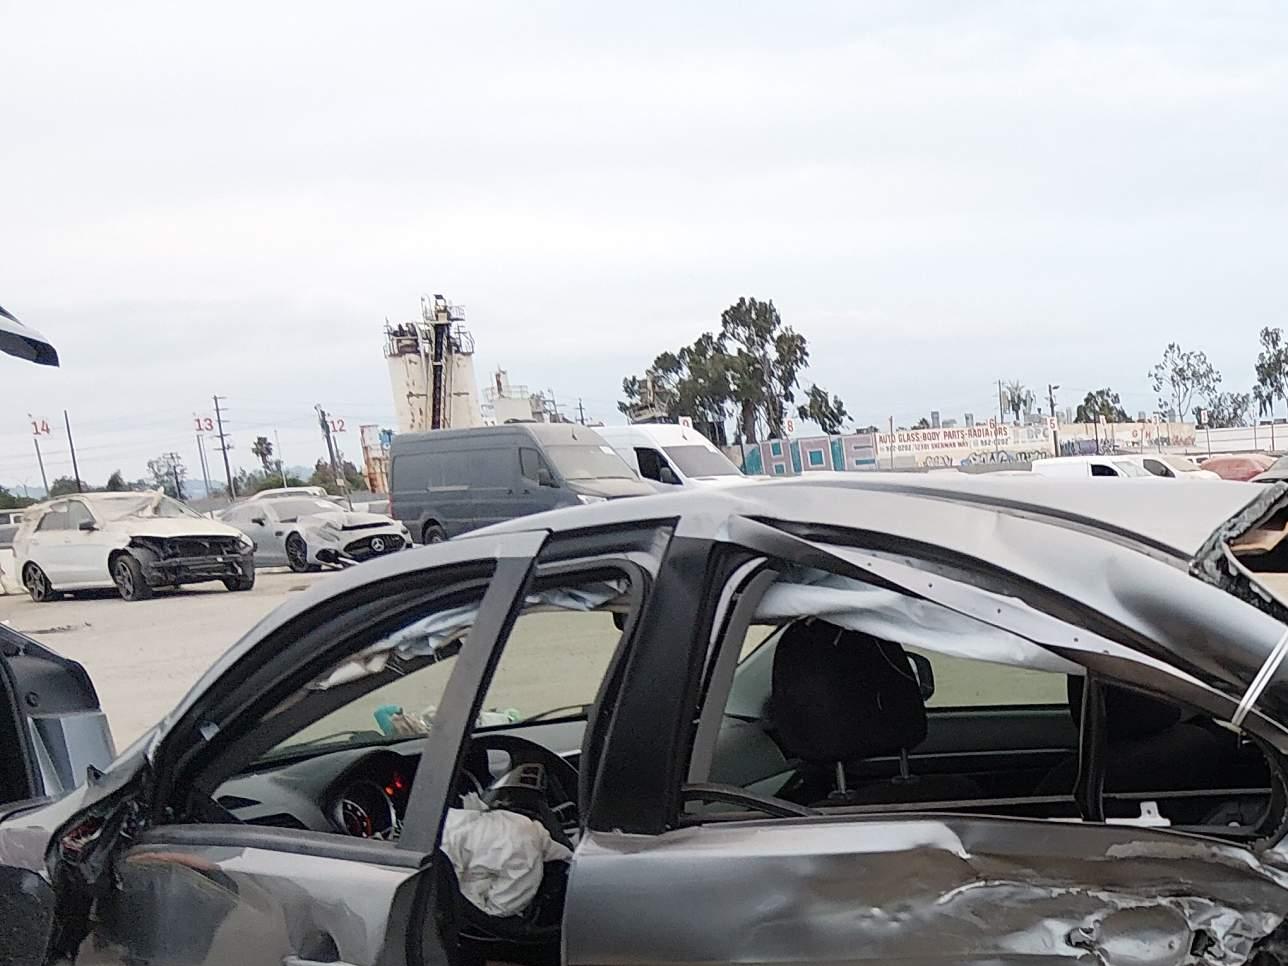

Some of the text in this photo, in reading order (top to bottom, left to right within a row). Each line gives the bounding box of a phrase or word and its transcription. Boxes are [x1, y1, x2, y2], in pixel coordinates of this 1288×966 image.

[31, 420, 50, 435] 14
[194, 418, 214, 431] 13
[330, 419, 346, 432] 12
[786, 420, 794, 432] 8
[989, 418, 995, 429] 6
[1049, 418, 1056, 429] 5
[879, 434, 896, 444] AUTO
